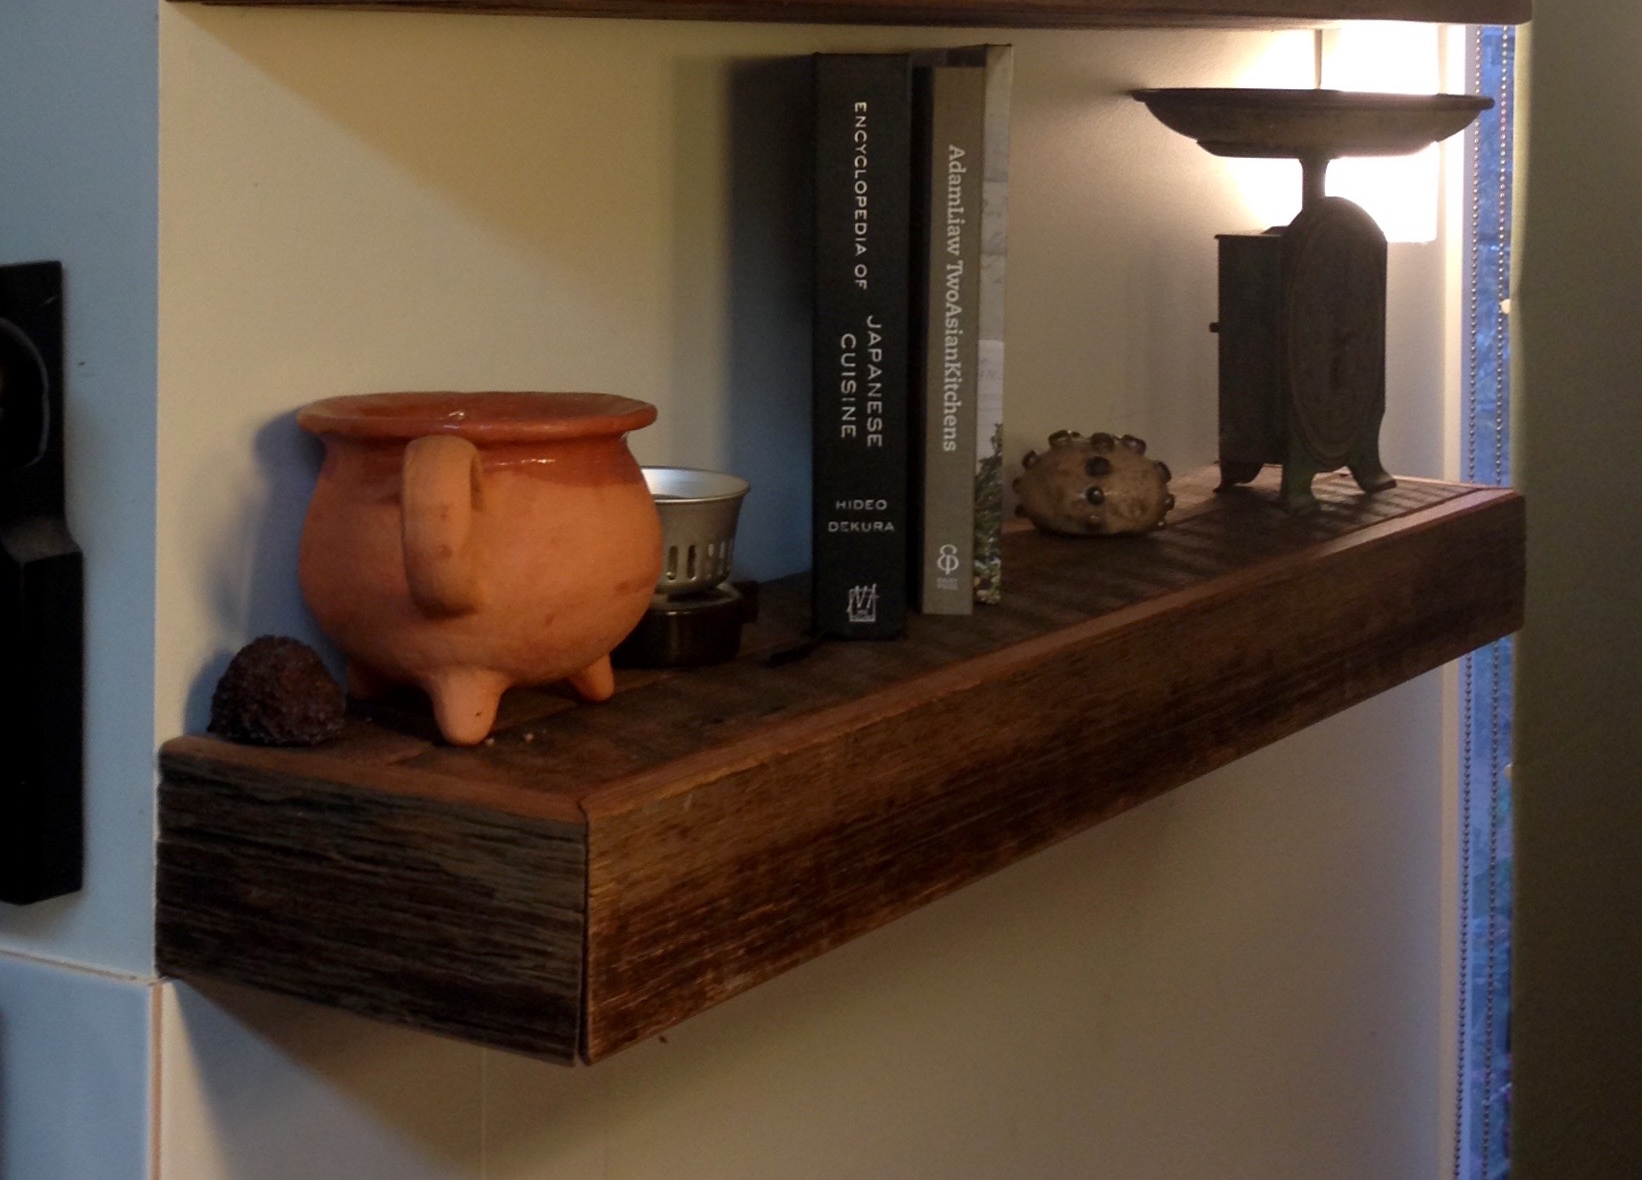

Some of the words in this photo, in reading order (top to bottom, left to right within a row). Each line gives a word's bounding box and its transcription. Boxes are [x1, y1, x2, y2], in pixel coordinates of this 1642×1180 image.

[854, 101, 867, 257] ENCYCLOPEDIA
[854, 264, 867, 290] OF
[841, 333, 856, 438] CUISINE
[866, 315, 882, 447] JAPANESE
[828, 521, 895, 533] DEKURA
[835, 498, 887, 510] HIDEO
